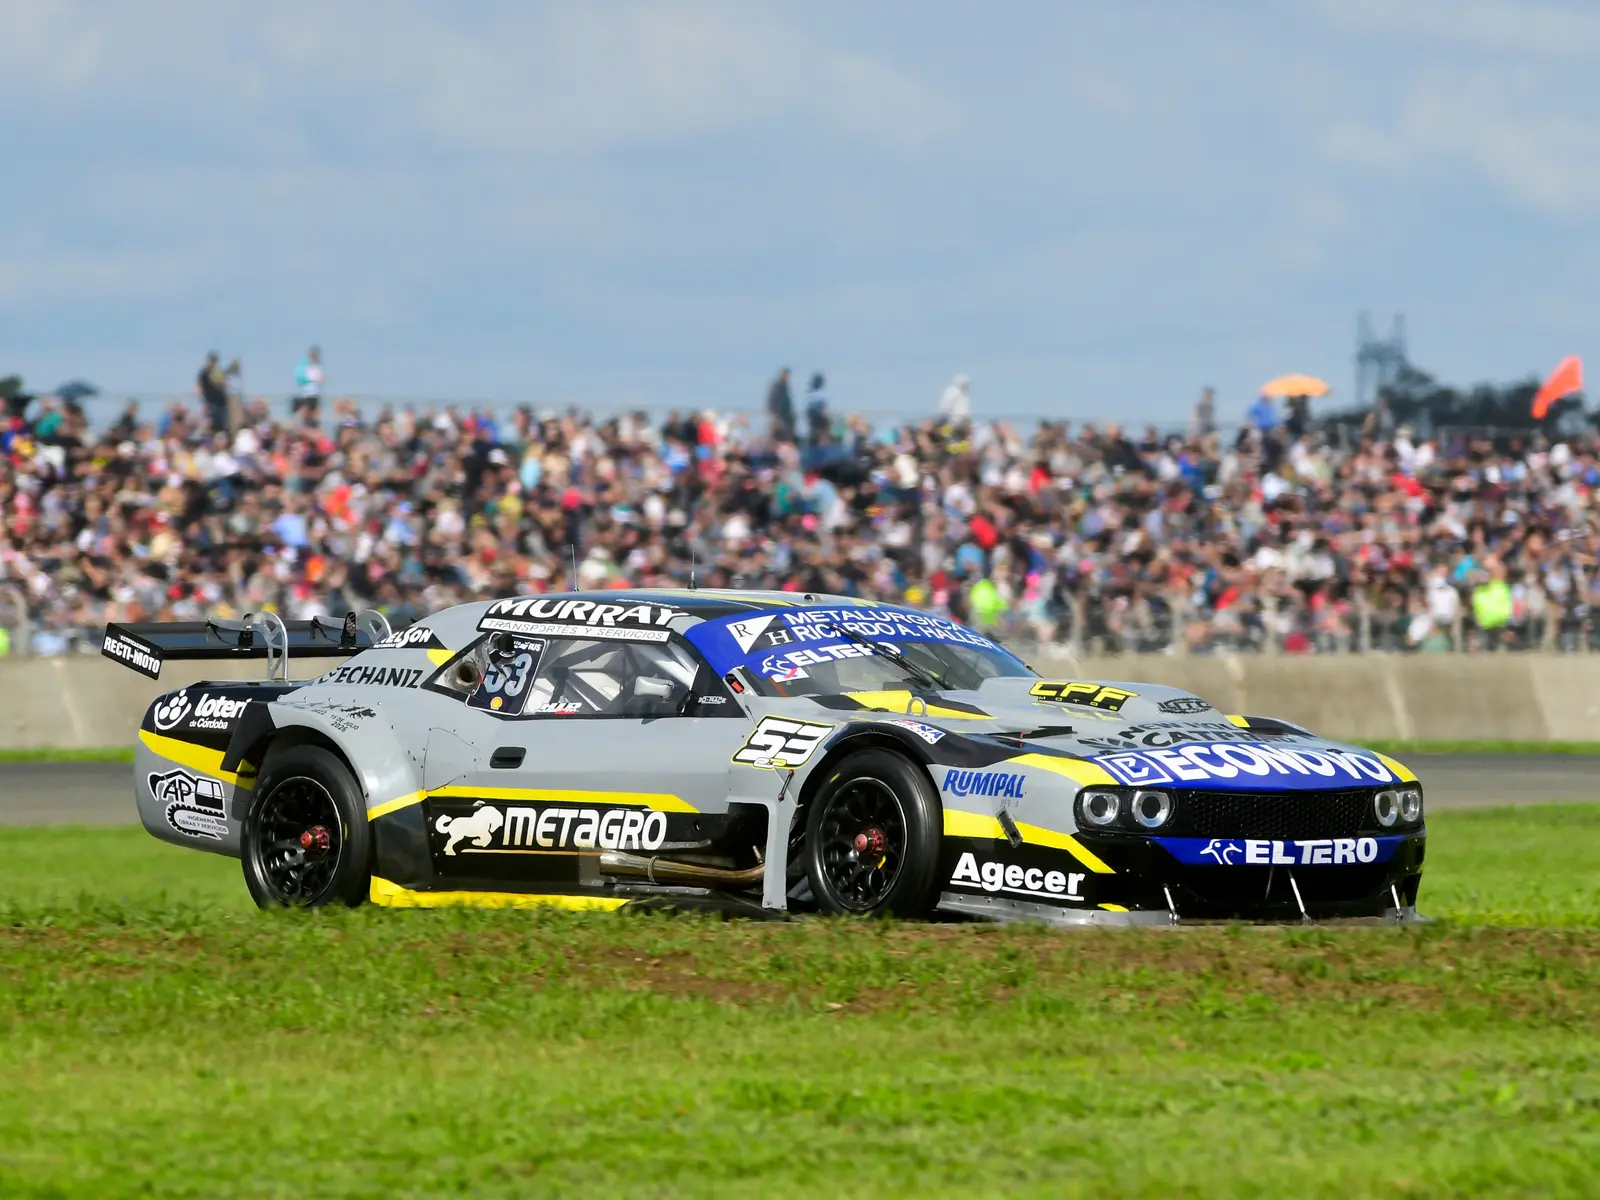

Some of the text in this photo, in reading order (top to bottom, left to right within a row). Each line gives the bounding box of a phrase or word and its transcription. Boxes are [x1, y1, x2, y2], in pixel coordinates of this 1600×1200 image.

[489, 600, 690, 625] MURRAY
[783, 610, 970, 634] METALURGICA
[381, 626, 434, 648] ELSON
[488, 620, 665, 641] TRANSPORTES Y SERVICIOS
[732, 623, 754, 639] R
[765, 629, 794, 646] H
[103, 636, 160, 674] RECTI-MOTO
[1029, 681, 1139, 703] CPF
[197, 717, 229, 730] Córdoba
[735, 717, 835, 767] 53
[1143, 744, 1393, 783] ECONOVO
[163, 779, 192, 802] AP
[942, 769, 1026, 798] RUMIPAL
[951, 852, 1086, 896] Agecer
